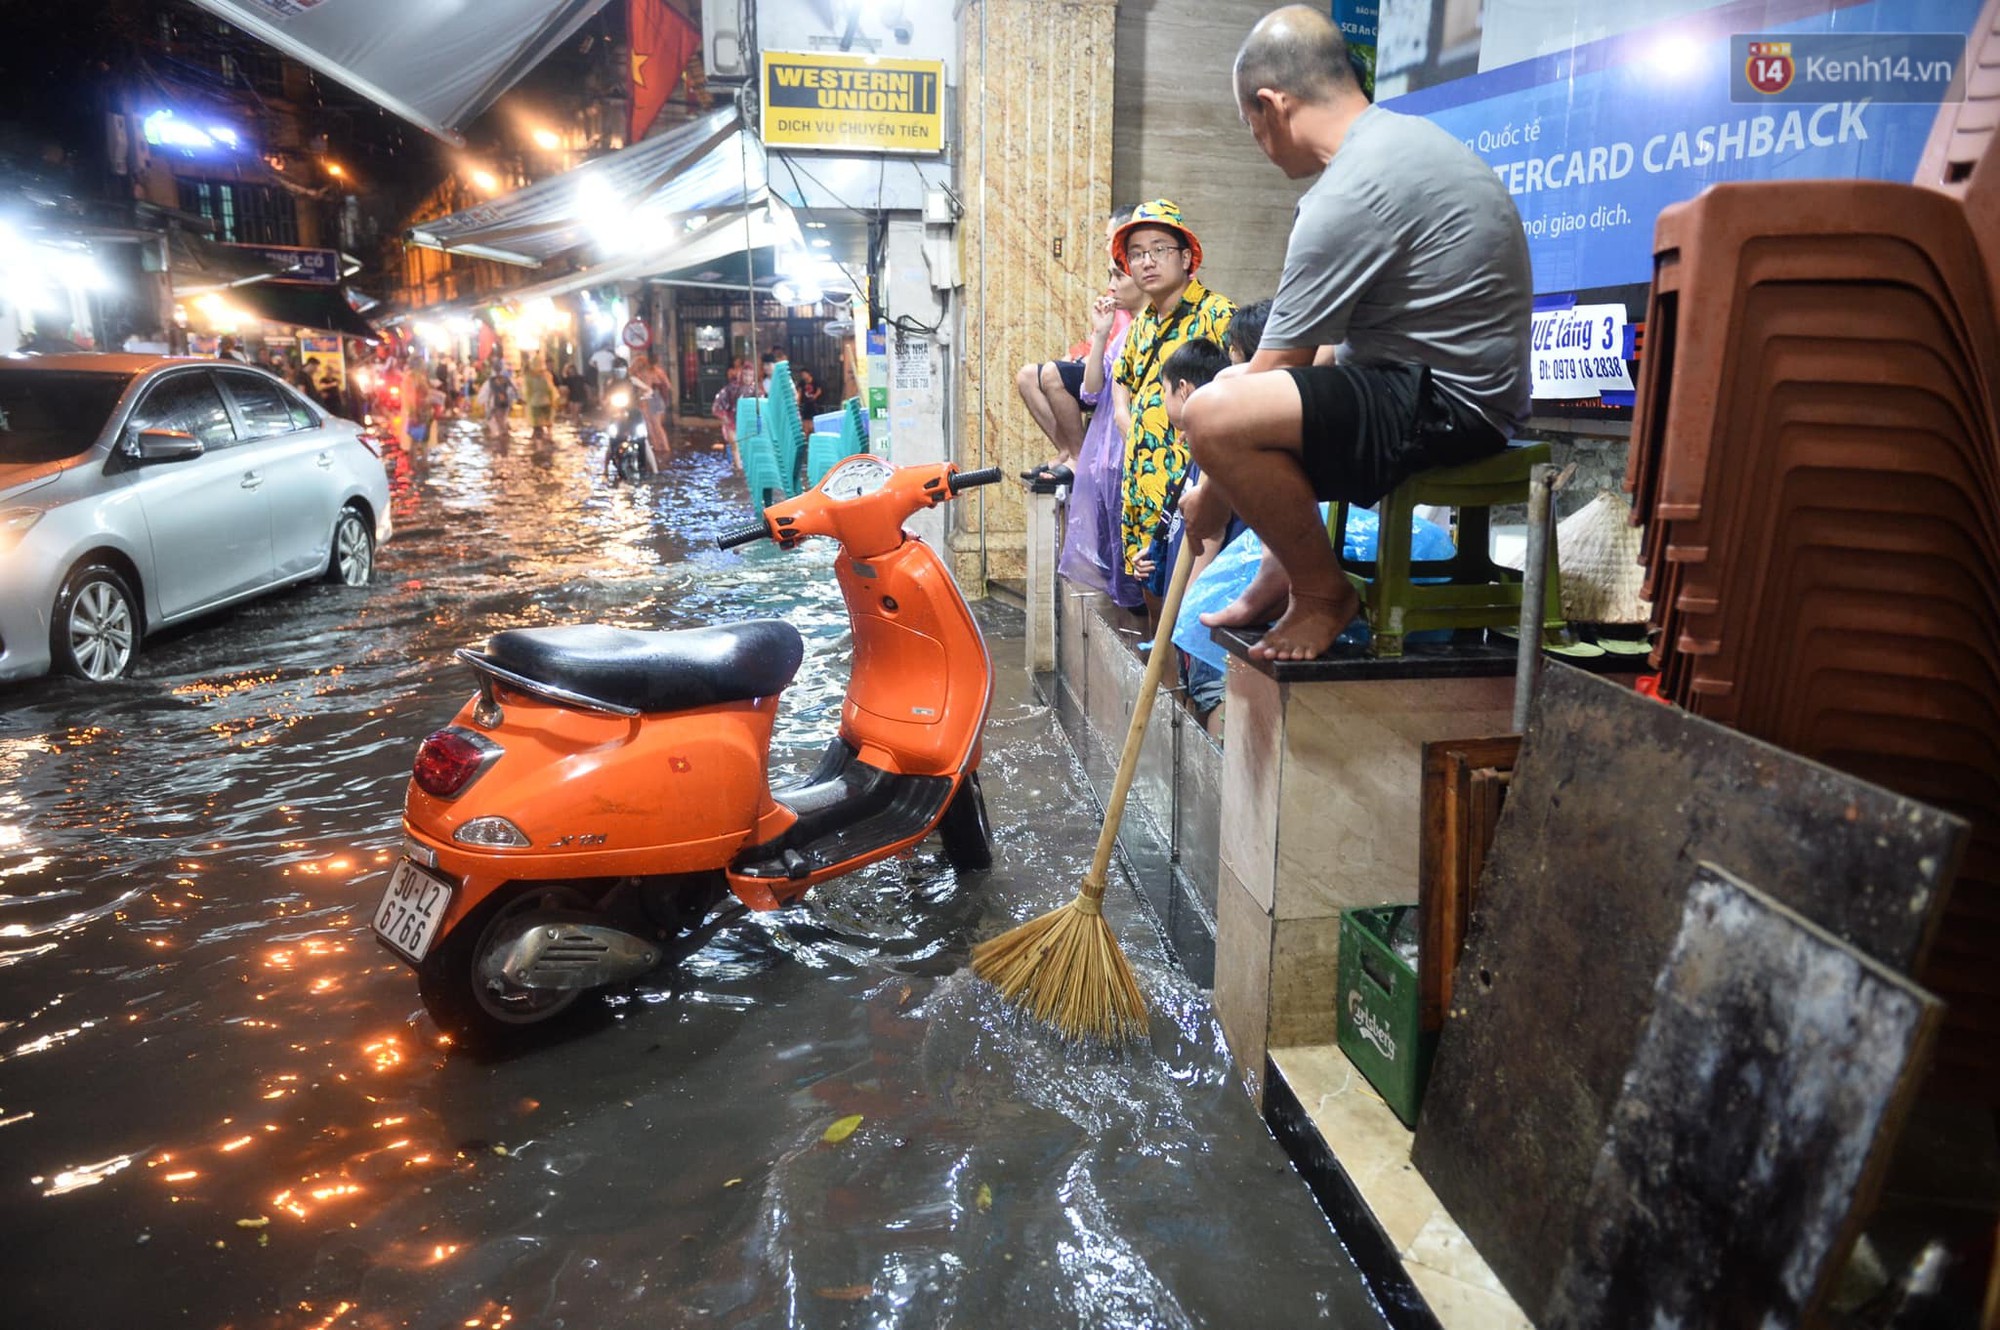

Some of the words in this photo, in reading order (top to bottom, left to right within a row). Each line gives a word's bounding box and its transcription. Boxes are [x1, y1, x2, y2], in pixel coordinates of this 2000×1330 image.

[1341, 21, 1357, 34] SCB
[1359, 24, 1371, 35] An
[775, 67, 908, 92] WESTERN
[817, 89, 909, 111] UNION
[778, 119, 810, 134] DỊCH
[816, 121, 834, 134] VỤ
[1478, 121, 1520, 152] Quốc
[1524, 117, 1542, 142] tế
[1493, 143, 1634, 195] TERCARD
[1642, 97, 1873, 173] CASHBACK
[1551, 212, 1586, 238] giao
[1590, 203, 1631, 231] dịch.
[1602, 316, 1614, 349] 3
[1553, 358, 1576, 380] 0979
[1578, 357, 1593, 378] 18
[1593, 356, 1623, 378] 2838
[380, 900, 426, 951] 6766
[1348, 989, 1395, 1061] Carlsberg
